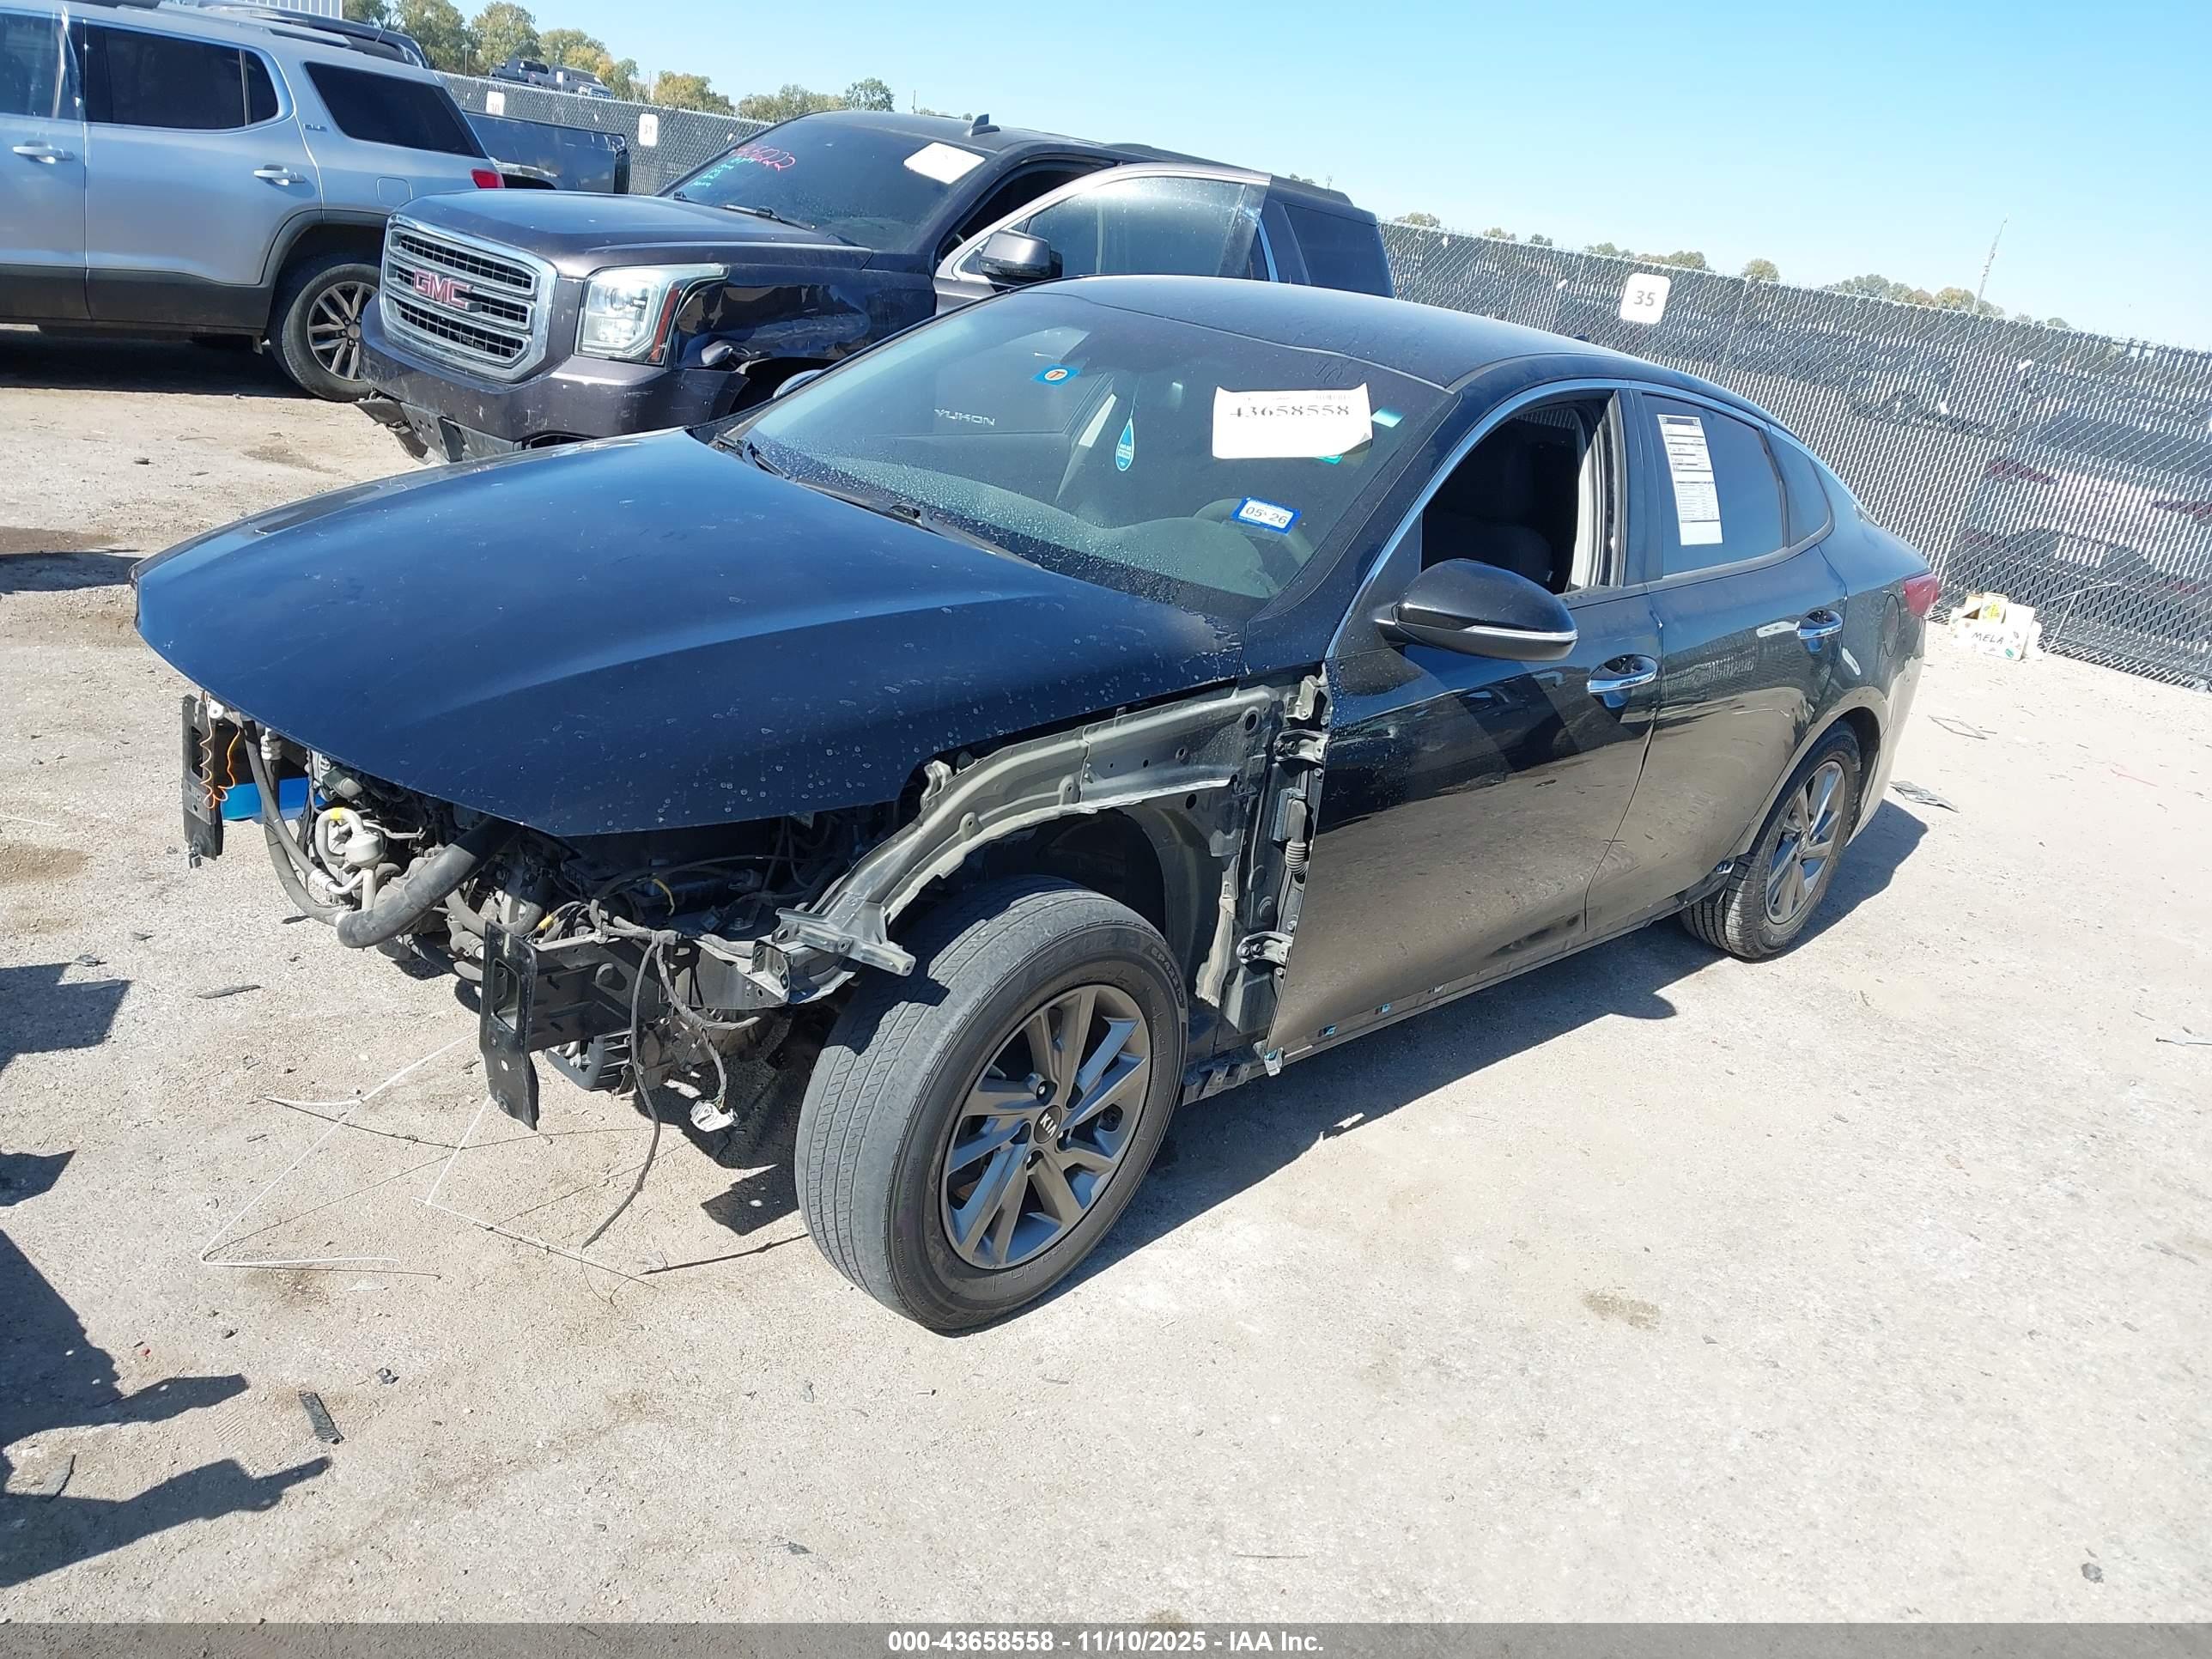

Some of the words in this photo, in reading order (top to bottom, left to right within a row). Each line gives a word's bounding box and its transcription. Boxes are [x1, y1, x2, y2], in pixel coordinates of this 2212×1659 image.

[414, 270, 471, 309] GMC
[1633, 290, 1656, 307] 35
[933, 409, 995, 427] YUKON
[1231, 404, 1350, 418] 43658558
[1040, 1113, 1056, 1137] KIA
